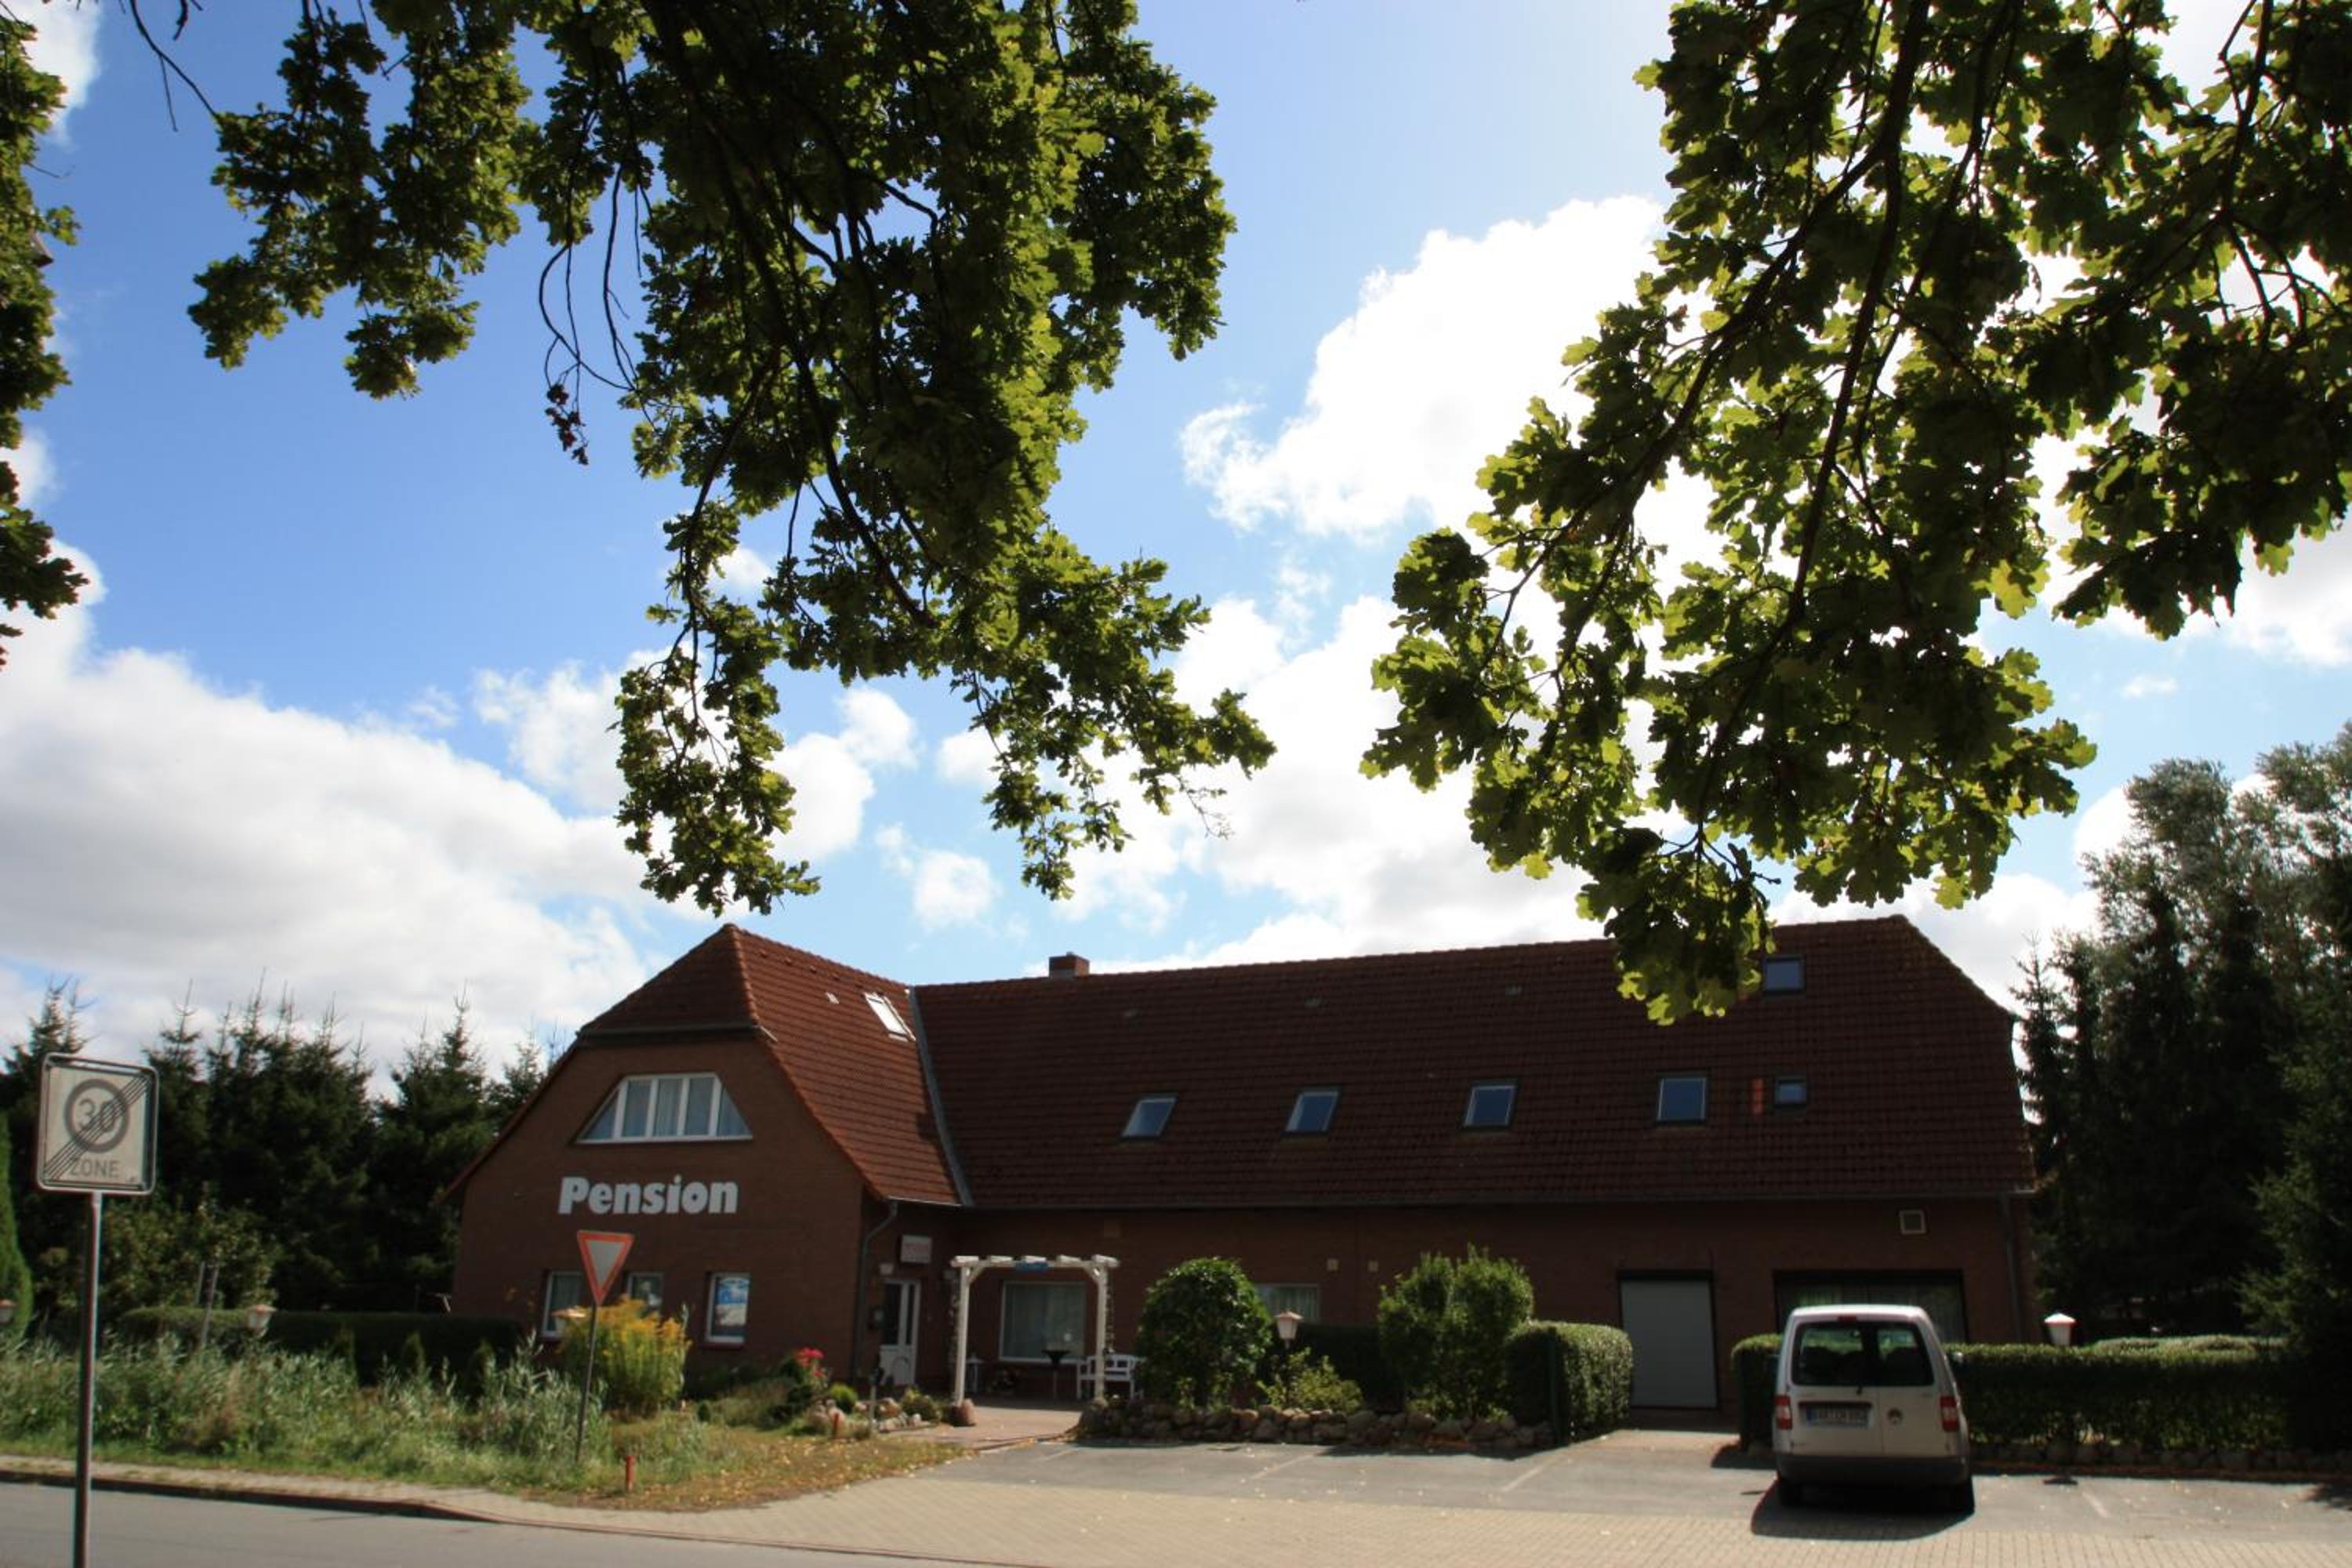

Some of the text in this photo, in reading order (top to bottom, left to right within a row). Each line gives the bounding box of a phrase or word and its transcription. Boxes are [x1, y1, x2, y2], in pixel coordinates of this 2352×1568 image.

[78, 1098, 117, 1131] 30
[71, 1156, 119, 1177] ZONE
[558, 1174, 738, 1214] Pension
